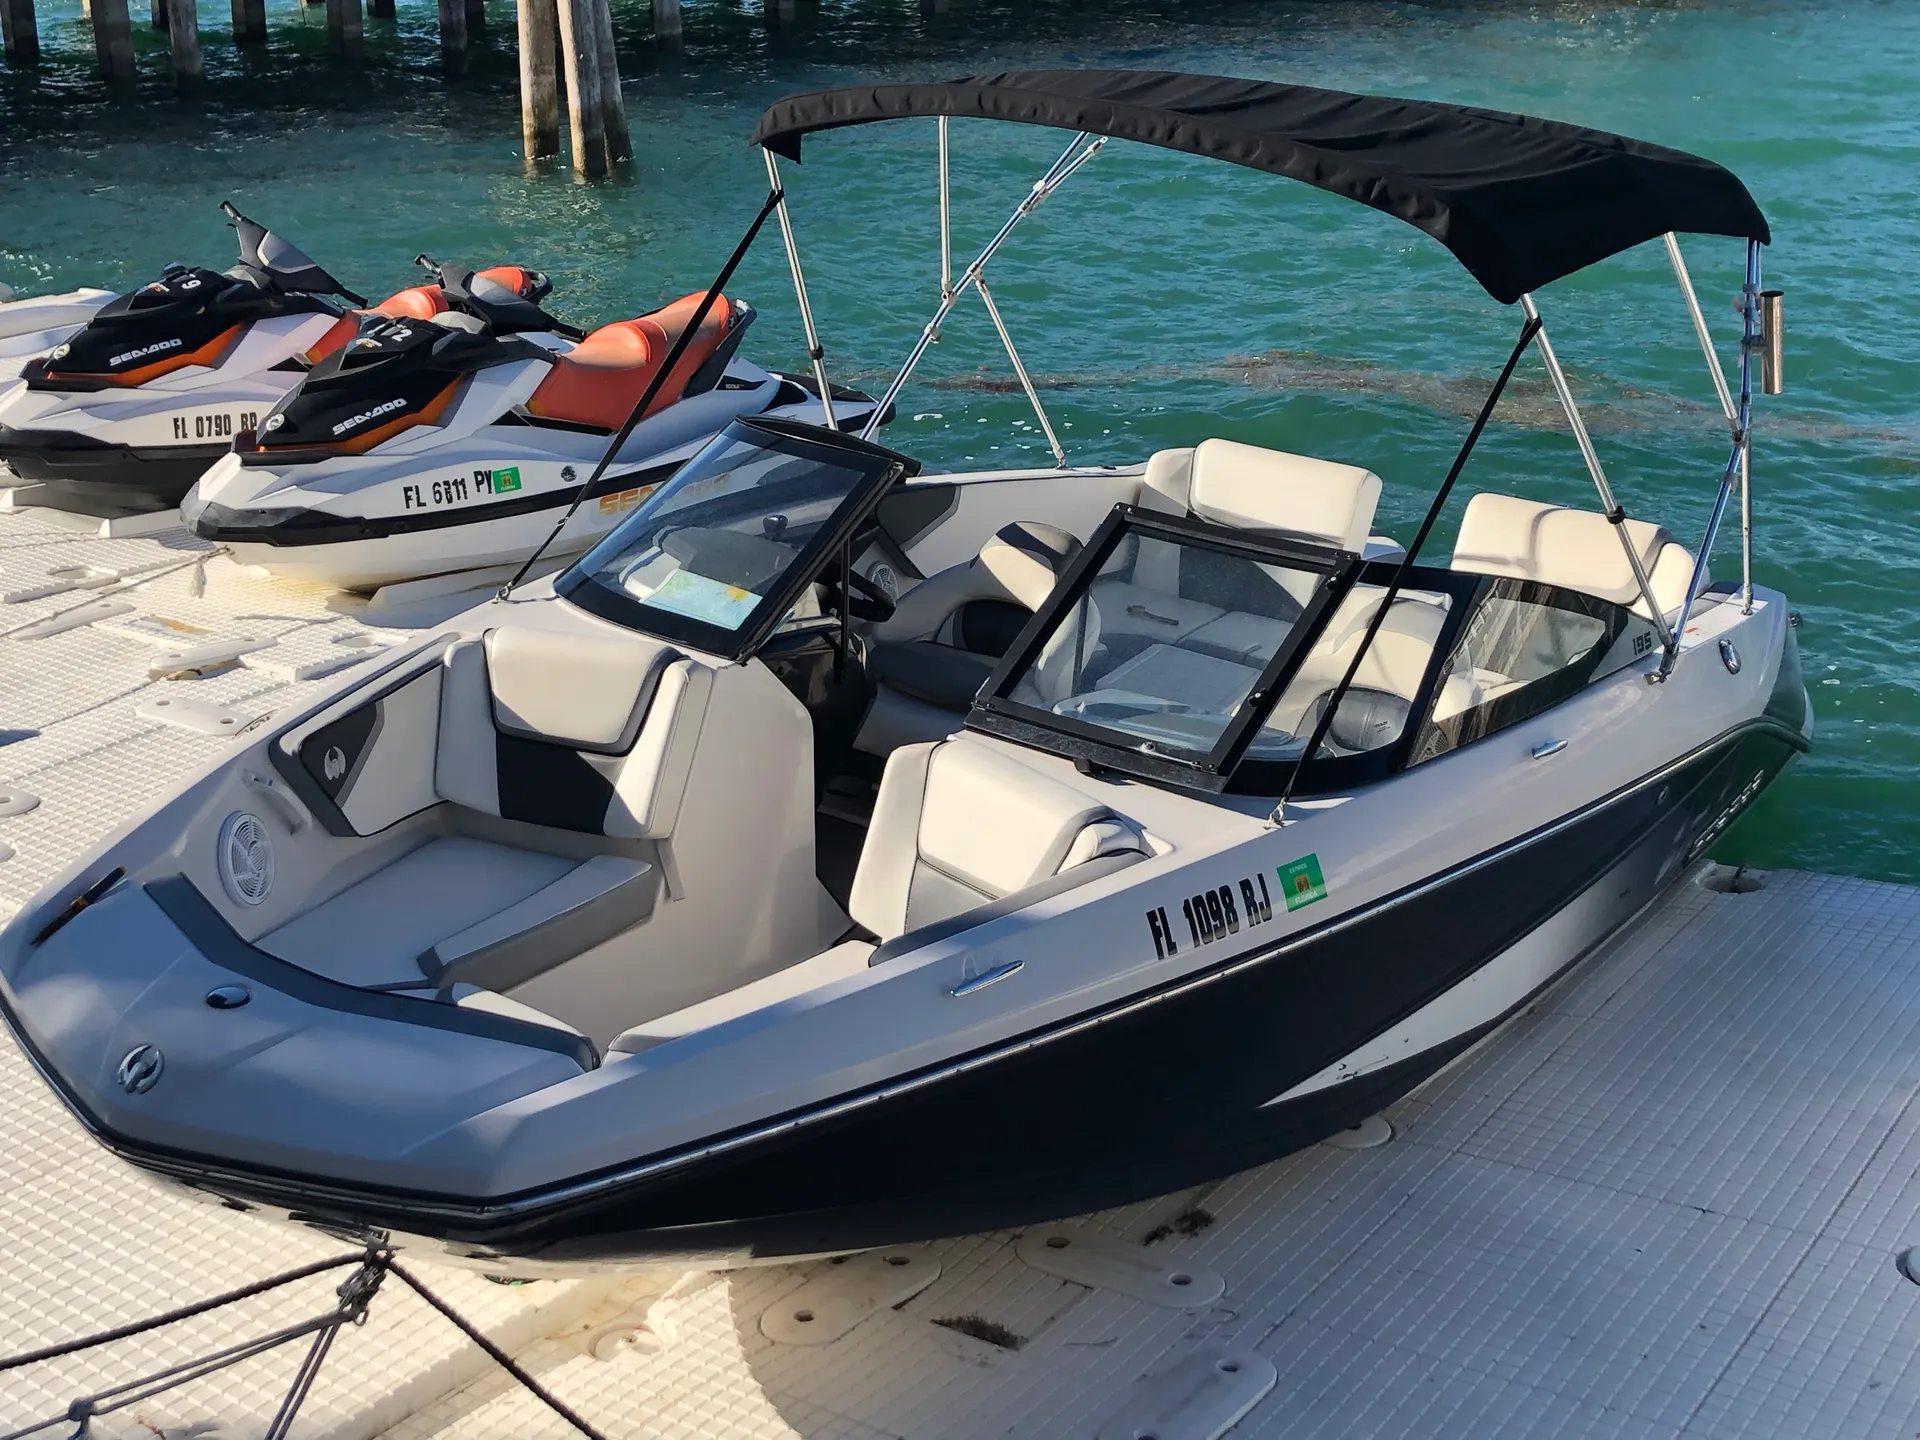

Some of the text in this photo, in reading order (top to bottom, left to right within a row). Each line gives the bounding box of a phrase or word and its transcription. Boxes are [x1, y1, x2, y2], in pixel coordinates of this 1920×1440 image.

[173, 416, 188, 439] FL
[195, 413, 231, 438] 0790
[403, 485, 427, 509] FL
[1632, 631, 1652, 656] 195
[1146, 872, 1272, 960] FL 1098 RJ
